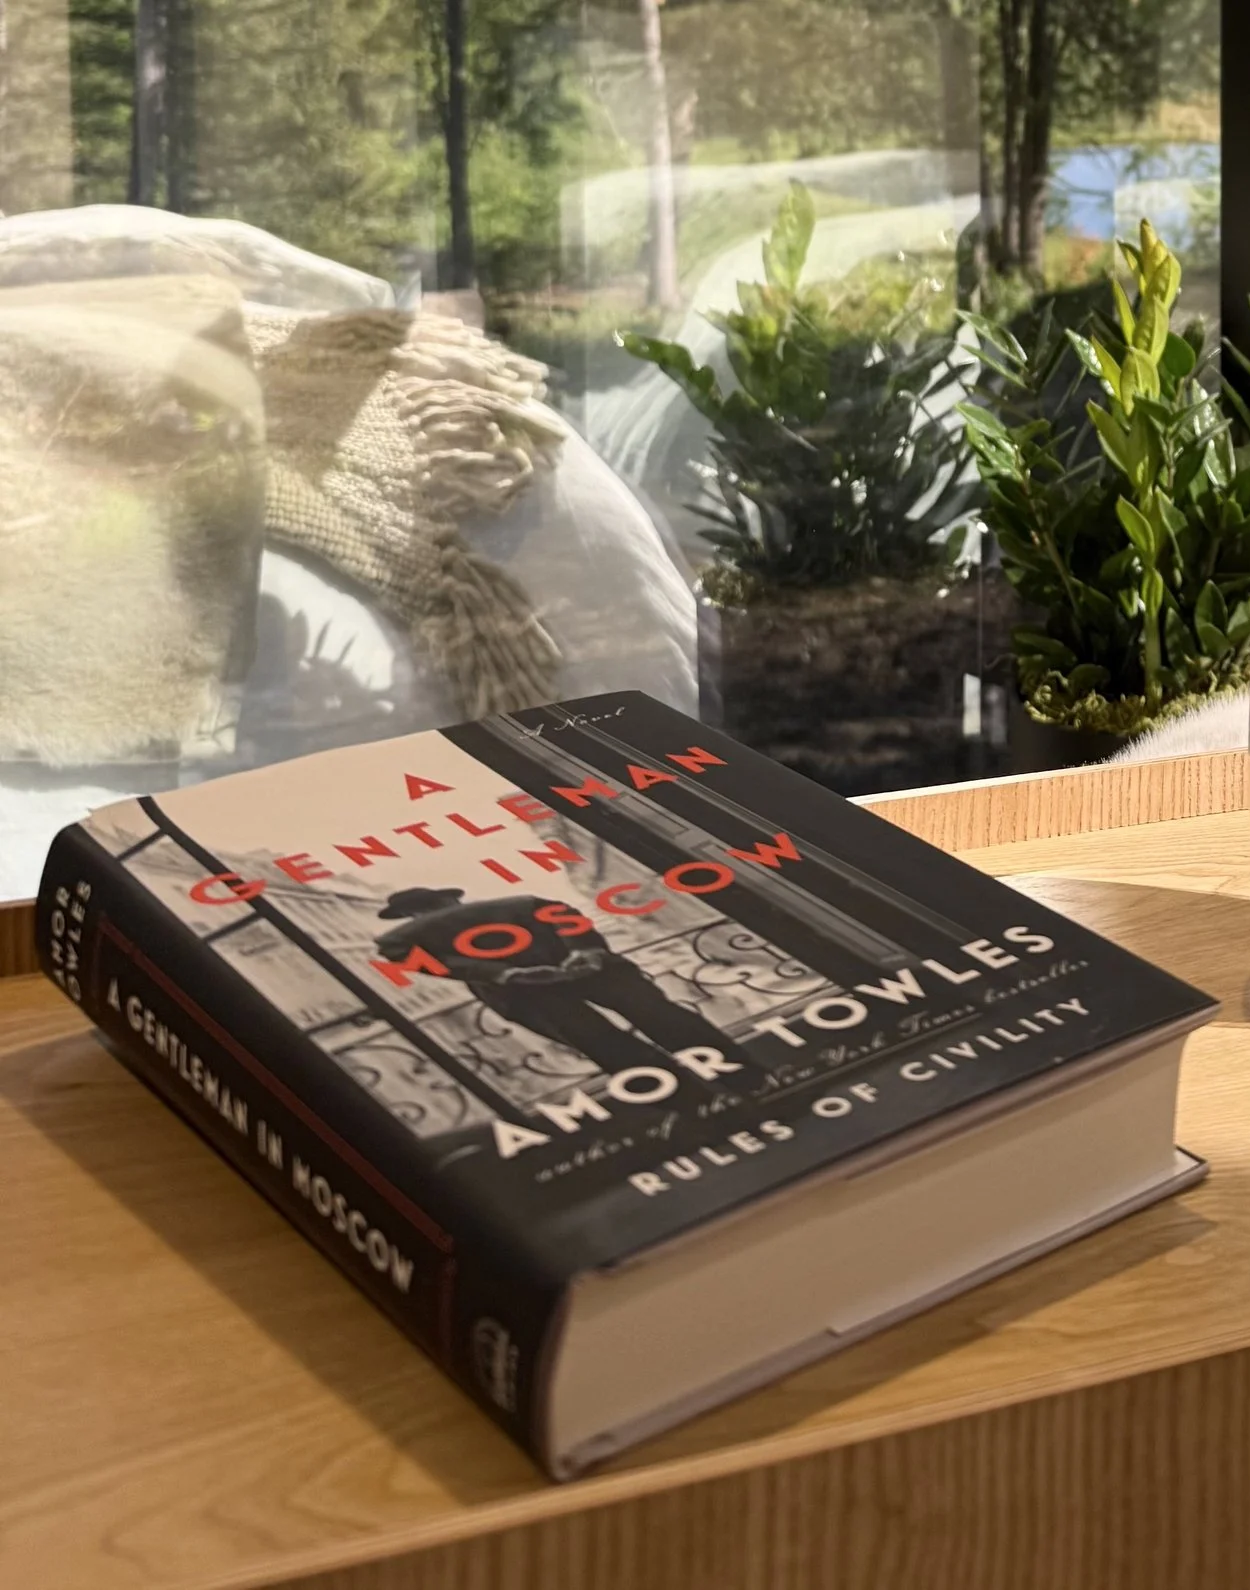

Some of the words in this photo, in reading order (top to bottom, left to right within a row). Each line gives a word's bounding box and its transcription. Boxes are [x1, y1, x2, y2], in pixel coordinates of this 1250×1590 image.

[189, 746, 729, 906] GENTLEMAN
[403, 772, 456, 802] A
[480, 839, 587, 884] IN
[66, 880, 92, 1001] OWLES
[368, 833, 804, 989] MOSCOW
[492, 1045, 744, 1158] AMOR
[753, 925, 1056, 1048] TOWLES
[628, 1120, 795, 1196] RULES
[812, 1081, 879, 1119] OF
[900, 998, 1090, 1082] CIVILITY
[646, 1111, 679, 1141] of
[697, 1093, 742, 1118] the
[899, 1004, 975, 1038] Times
[107, 978, 121, 1012] A
[126, 995, 249, 1135] GENTLEMAN
[257, 1120, 284, 1171] IN
[292, 1156, 414, 1294] MOSCOW
